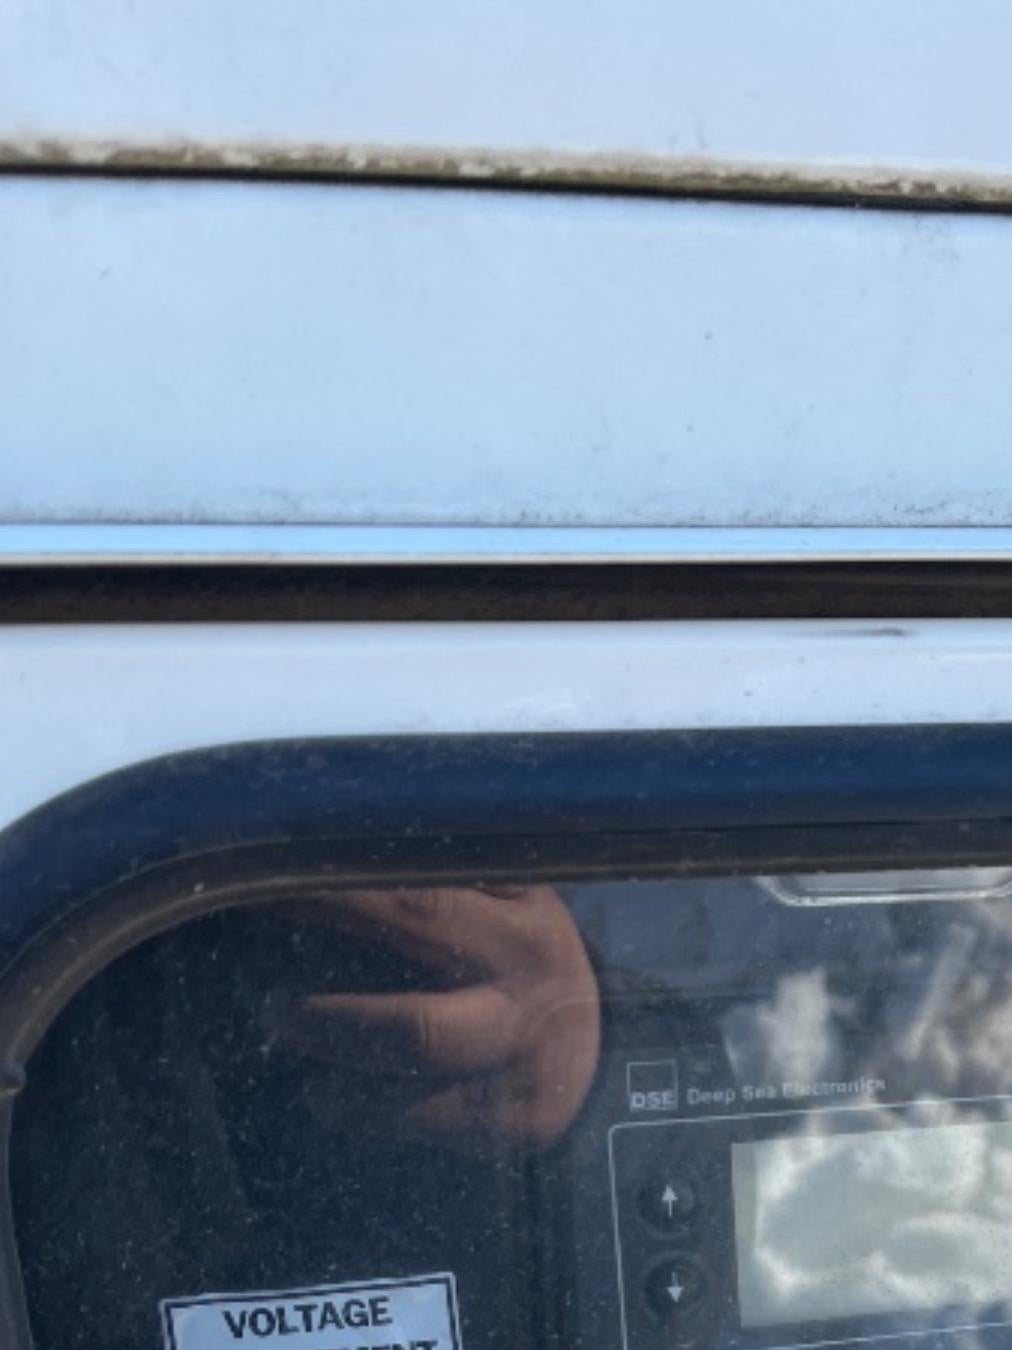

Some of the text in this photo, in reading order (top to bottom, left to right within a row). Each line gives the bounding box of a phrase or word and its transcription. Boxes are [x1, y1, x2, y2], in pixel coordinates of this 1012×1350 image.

[631, 1076, 886, 1108] DSE Deep Sea Electronics
[222, 1297, 393, 1339] VOLTAGE
